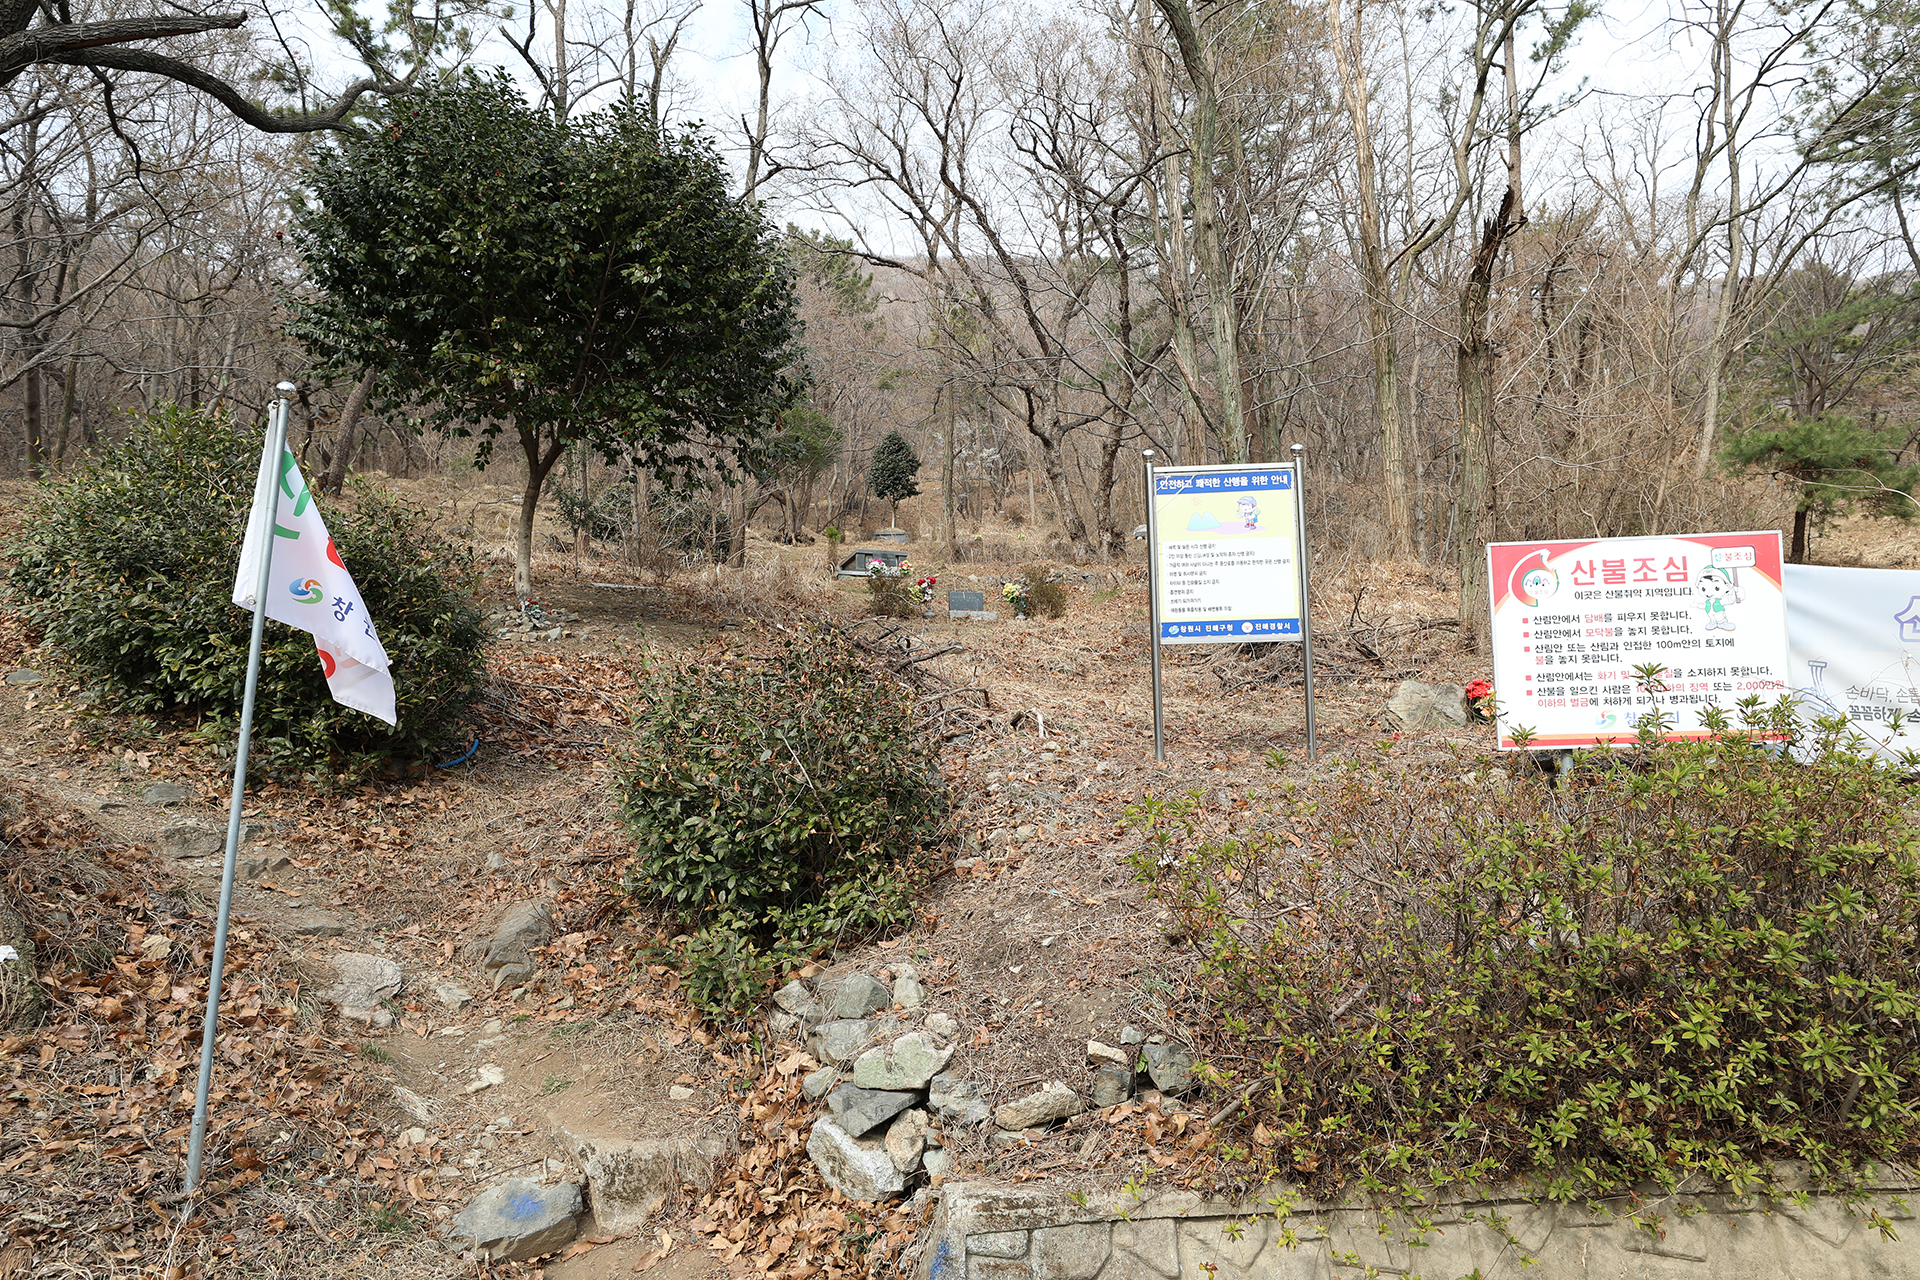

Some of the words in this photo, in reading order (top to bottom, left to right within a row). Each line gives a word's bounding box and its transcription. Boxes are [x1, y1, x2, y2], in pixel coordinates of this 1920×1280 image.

[1160, 479, 1193, 490] 안전하고
[1196, 476, 1220, 488] 쾌적한
[1224, 476, 1248, 486] 산행을
[1251, 475, 1268, 485] 위한
[1271, 475, 1288, 484] 안내
[1714, 552, 1752, 562] 산불조심
[1571, 556, 1688, 585] 산불조심
[1574, 591, 1602, 600] 이곳은
[1605, 589, 1642, 599] 산불취약
[1646, 587, 1694, 597] 지역입니다.
[1533, 615, 1580, 625] 산림안에서
[1585, 613, 1613, 623] 담배를
[1617, 612, 1646, 622] 피우지
[1650, 611, 1692, 621] 못합니다.
[1534, 629, 1580, 639] 산림안에서
[1586, 627, 1623, 637] 모닥불을
[1628, 627, 1646, 636] 놓지
[1651, 625, 1692, 635] 못합니다.
[1535, 643, 1562, 653] 산림안
[1567, 643, 1585, 652] 또는
[1591, 641, 1619, 651] 산림과
[1623, 641, 1651, 650] 인접한
[1657, 639, 1700, 649] 100m안의
[1705, 638, 1734, 648] 토지에
[1535, 656, 1554, 665] 불을
[1558, 655, 1577, 664] 놓지
[1582, 653, 1622, 663] 못합니다.
[1536, 672, 1593, 682] 산림안에서는
[1597, 671, 1616, 680] 화기
[1621, 670, 1630, 679] 및
[1687, 667, 1726, 677] 소지하지
[1730, 666, 1772, 676] 못합니다.
[1537, 686, 1564, 696] 산불을
[1570, 685, 1598, 695] 일으킨
[1602, 684, 1631, 694] 사람은
[1690, 683, 1708, 692] 징역
[1713, 682, 1732, 691] 또는
[1845, 685, 1892, 703] 손바닥,
[1538, 698, 1566, 707] 이하의
[1570, 697, 1598, 707] 벌금에
[1604, 695, 1632, 706] 처하게
[1636, 694, 1665, 704] 되거나
[1669, 694, 1721, 704] 병과됩니다.
[1624, 710, 1679, 725] 창시
